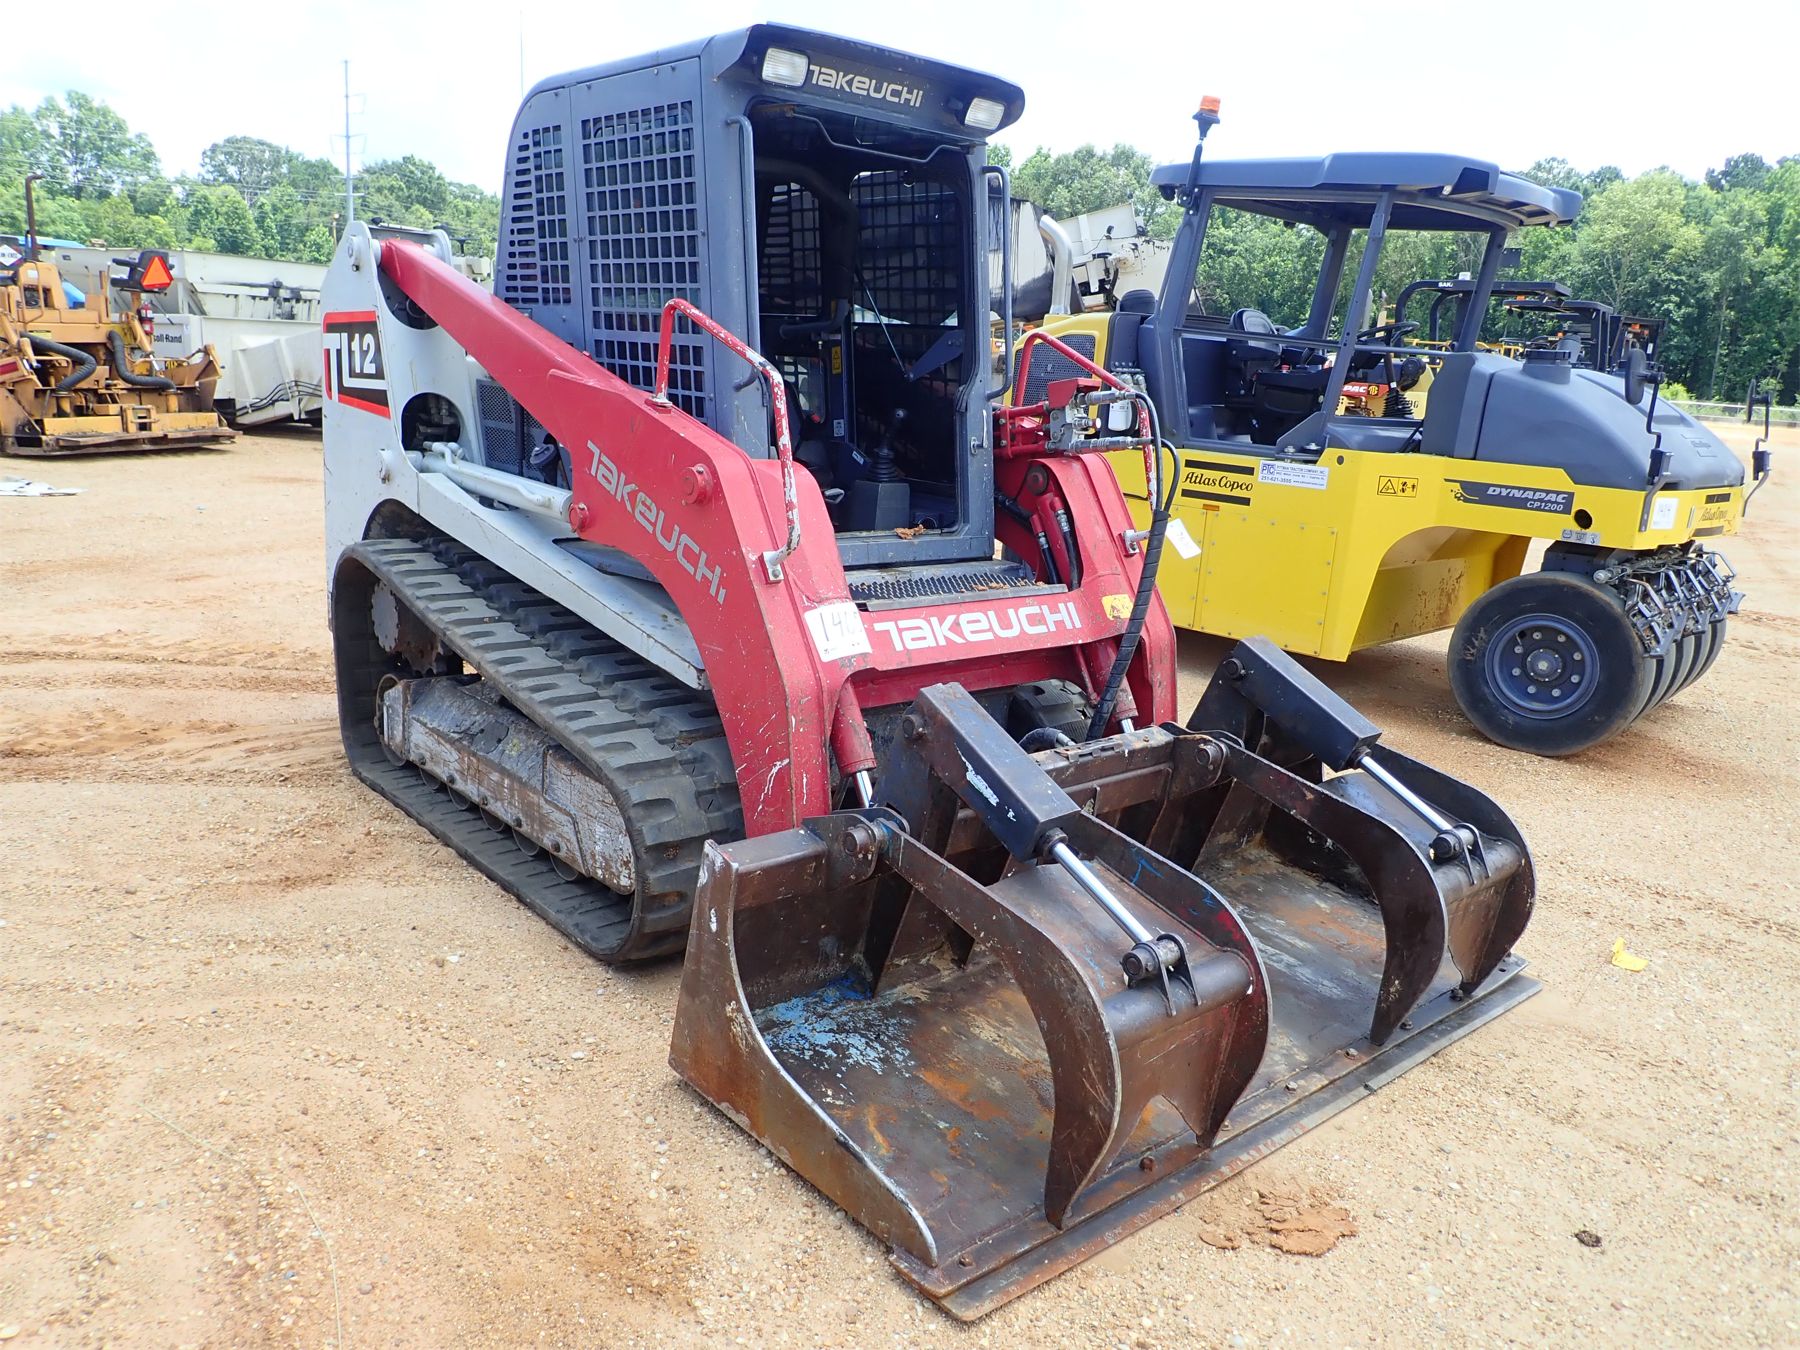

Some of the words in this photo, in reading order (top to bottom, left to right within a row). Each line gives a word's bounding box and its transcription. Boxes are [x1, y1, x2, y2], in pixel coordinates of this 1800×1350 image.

[1182, 471, 1217, 487] Atlas
[1218, 475, 1253, 492] Copco
[1487, 486, 1569, 503] DYNAPAC
[1526, 501, 1564, 511] CP1200
